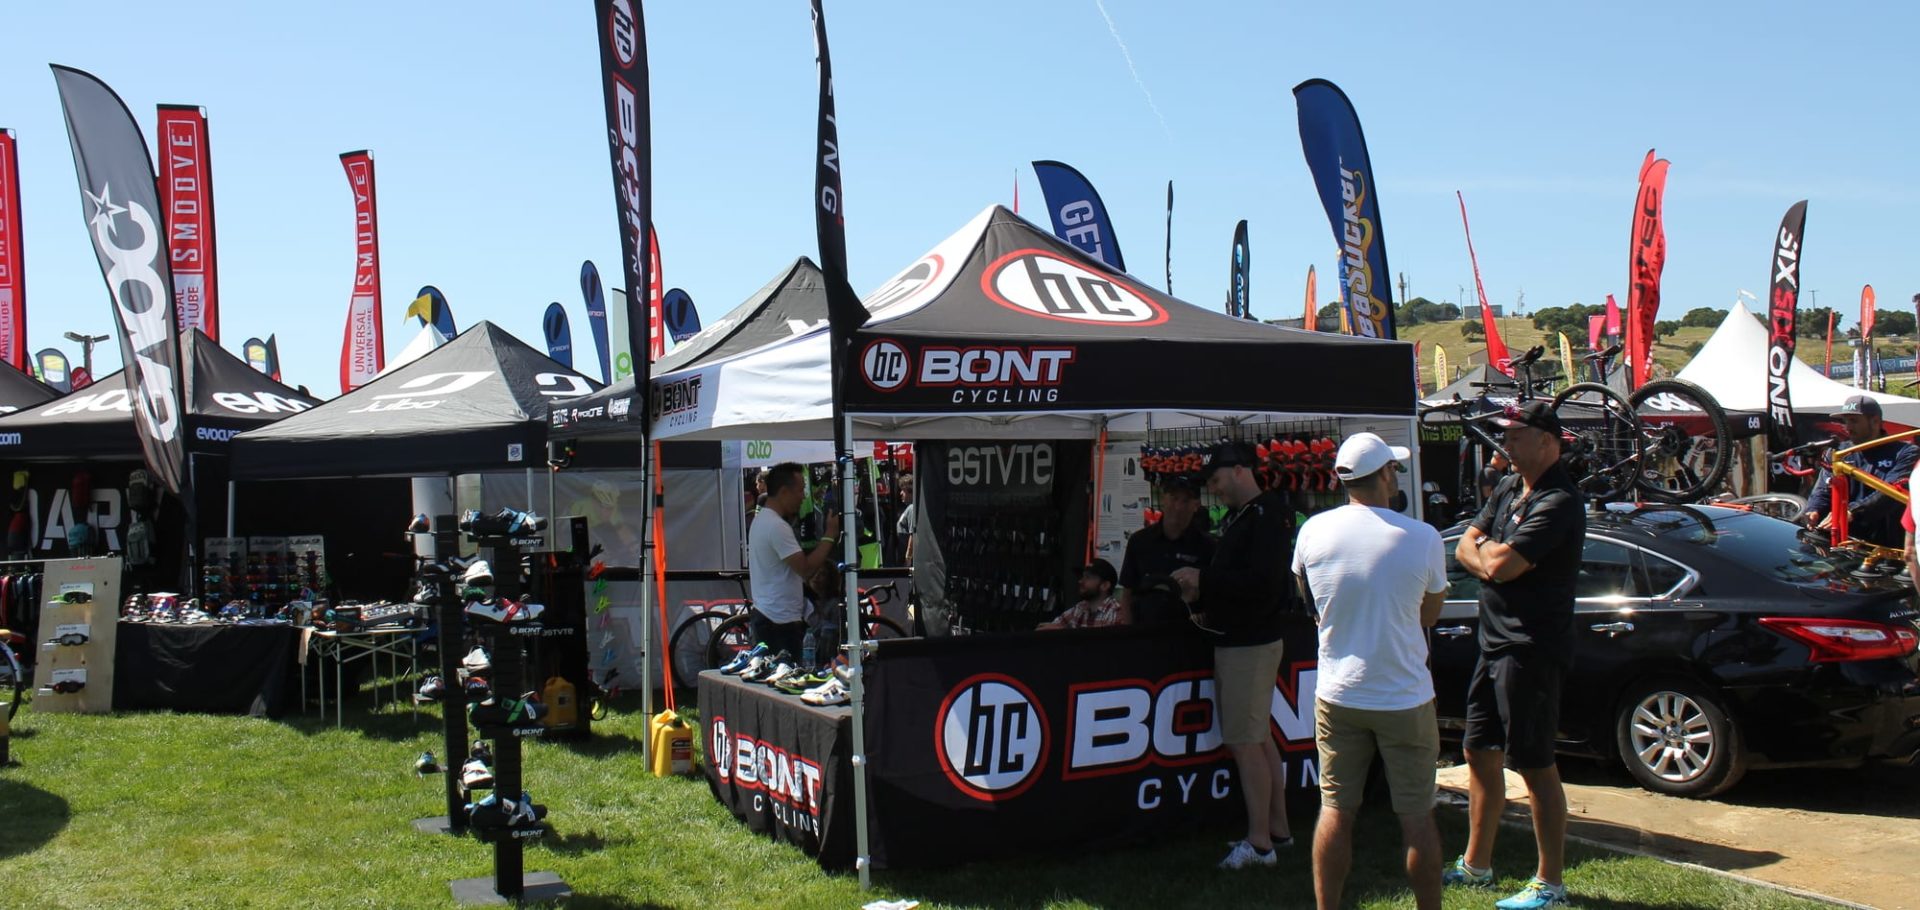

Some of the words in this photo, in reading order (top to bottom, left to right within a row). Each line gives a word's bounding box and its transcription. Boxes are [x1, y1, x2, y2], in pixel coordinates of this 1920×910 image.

[172, 129, 198, 262] SMOOVE
[1775, 225, 1798, 289] SIX
[188, 286, 200, 314] LUBE
[355, 309, 367, 373] UNIVERSAL
[919, 349, 1073, 384] BONT
[662, 376, 702, 415] BONT
[952, 388, 1060, 403] CYCLING
[1769, 345, 1793, 428] ONE
[669, 411, 699, 427] CYCLING
[746, 439, 772, 459] alto
[1071, 670, 1318, 769] BON
[736, 738, 821, 808] BONT
